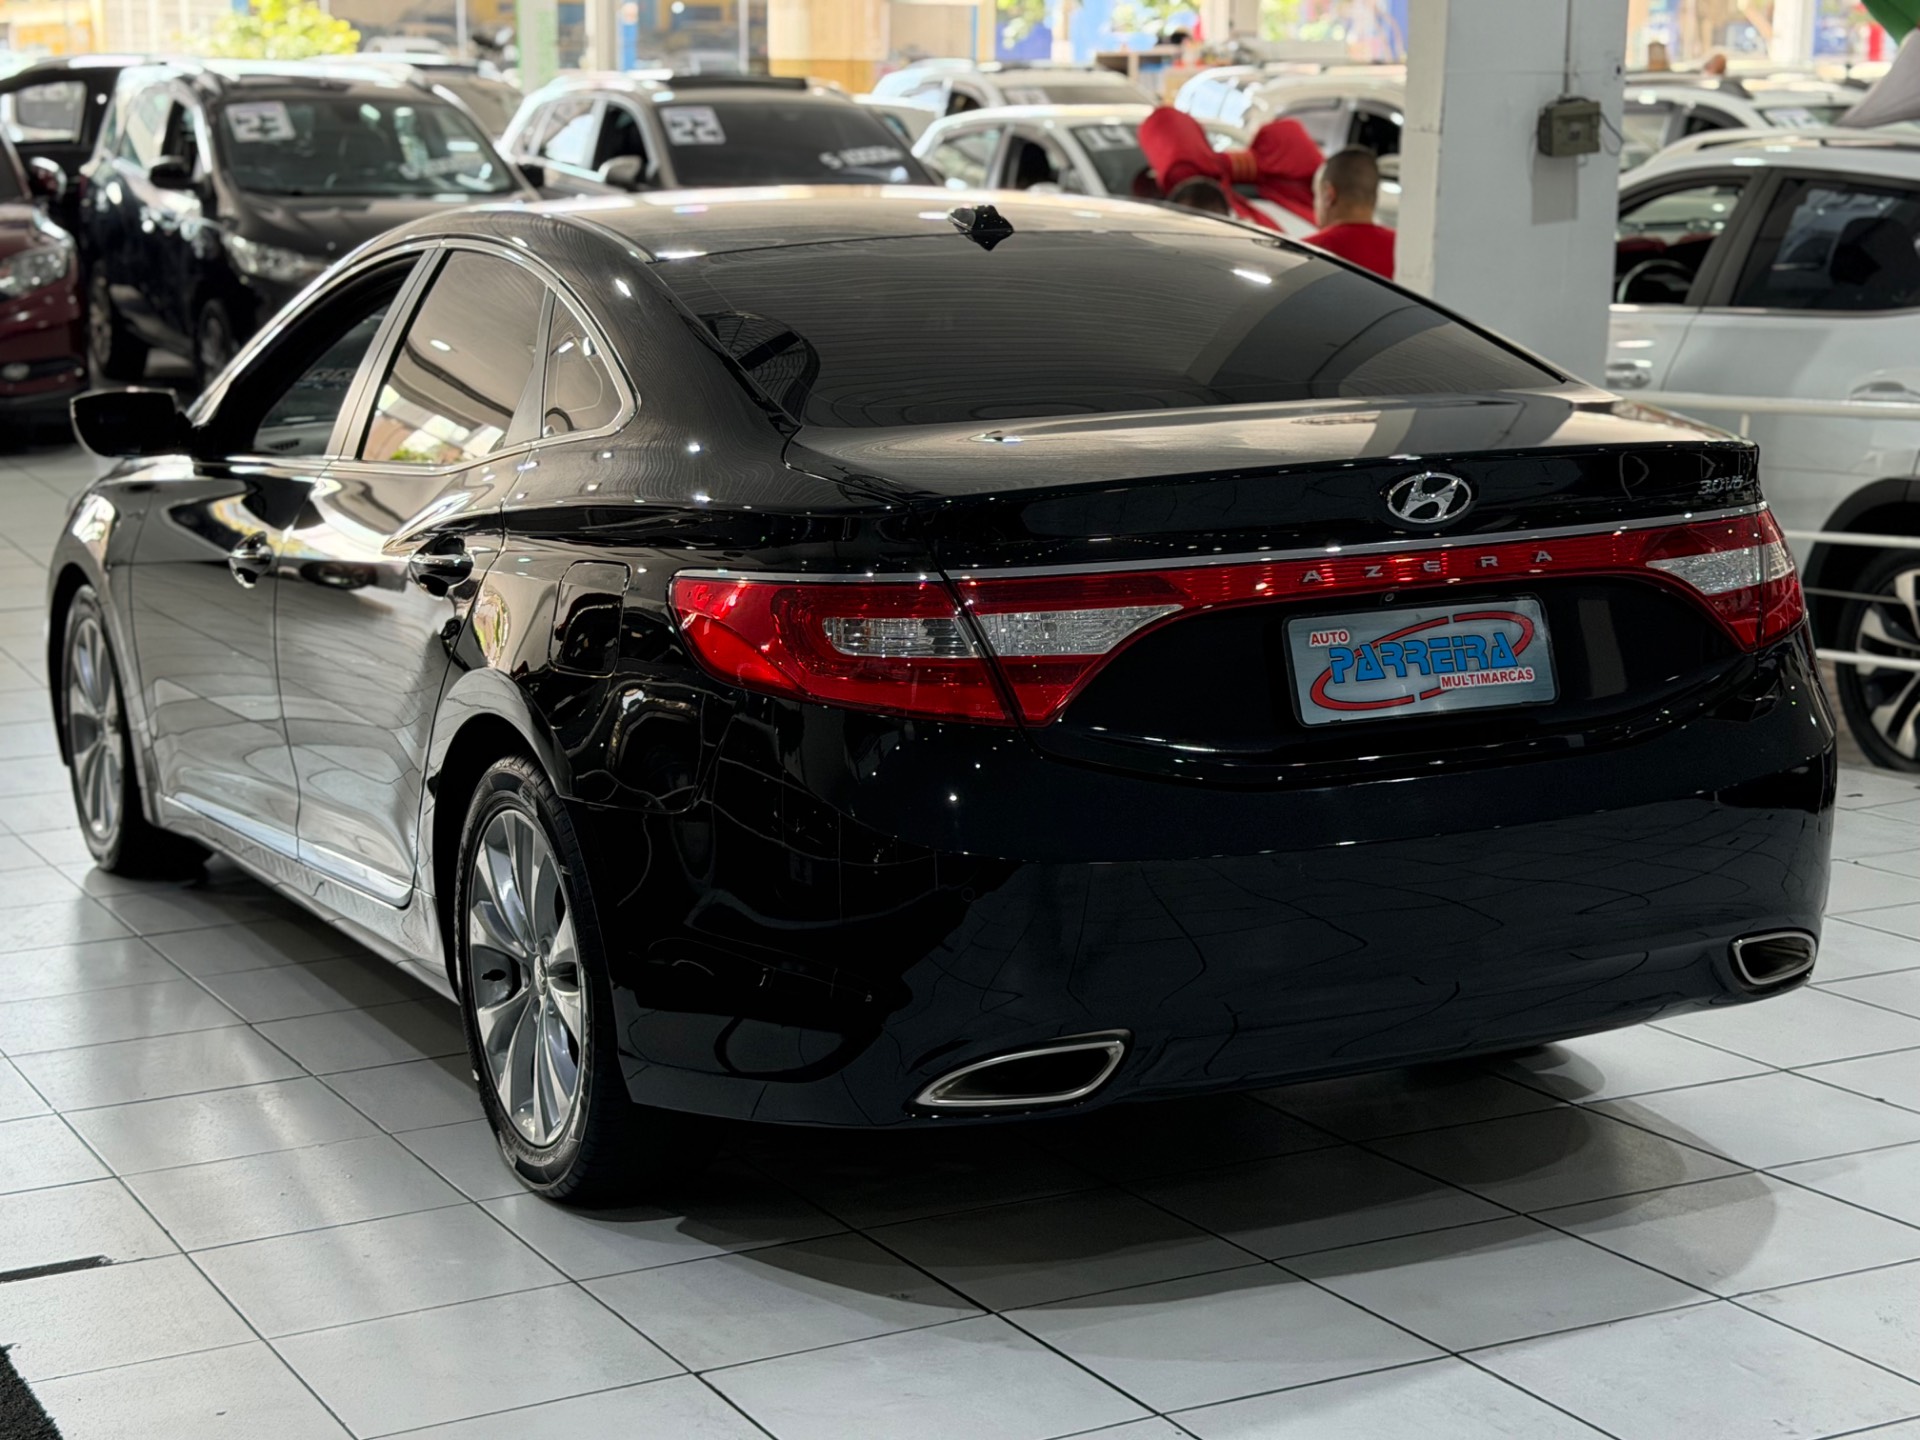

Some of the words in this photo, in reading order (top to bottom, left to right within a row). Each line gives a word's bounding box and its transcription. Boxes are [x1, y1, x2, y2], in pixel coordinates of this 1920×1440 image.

[1302, 550, 1553, 583] AZERA
[1310, 630, 1349, 646] AUTO
[1328, 631, 1519, 684] PARREIRA
[1440, 668, 1534, 688] MULTIMARCAS
